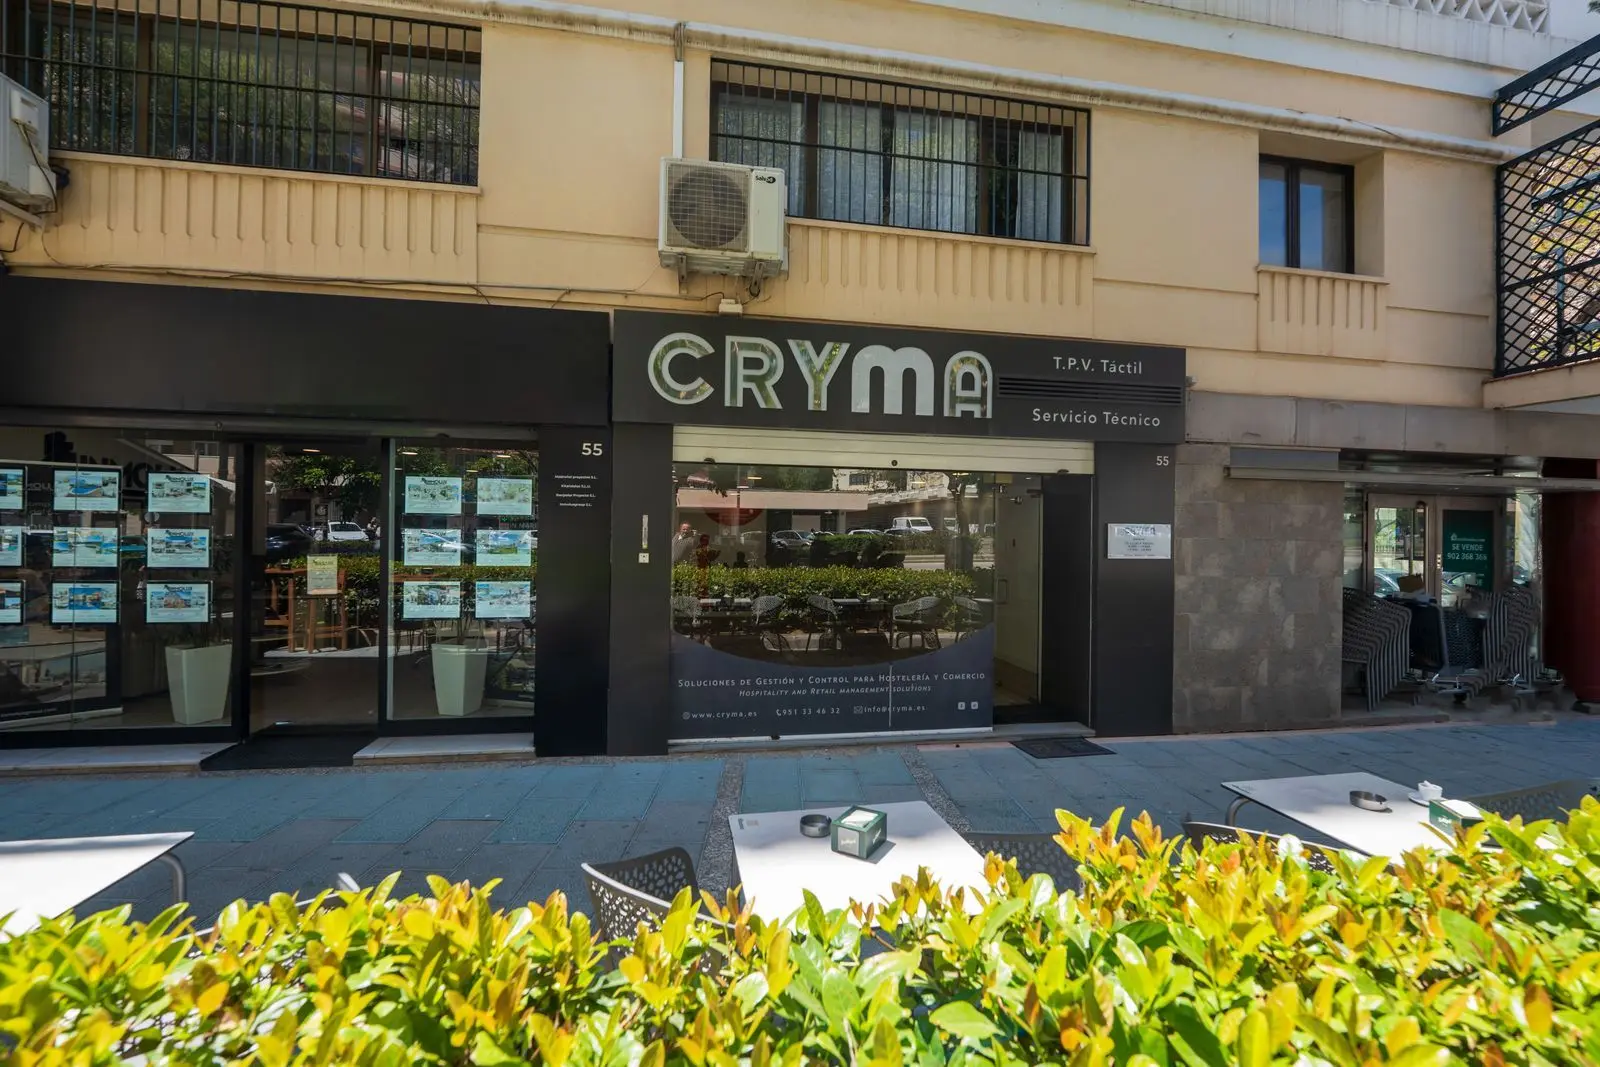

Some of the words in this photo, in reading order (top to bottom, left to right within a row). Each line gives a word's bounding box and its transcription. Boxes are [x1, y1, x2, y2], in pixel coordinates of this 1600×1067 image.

[1052, 356, 1095, 372] T.P.V.
[1100, 359, 1142, 375] Táctil
[647, 331, 993, 419] CRYMA
[1032, 407, 1097, 424] Servicio
[1102, 411, 1161, 427] Técnico
[581, 442, 603, 457] 55
[1155, 455, 1170, 467] 55
[1451, 543, 1461, 551] SE
[1461, 543, 1484, 552] VENDE
[1447, 552, 1460, 560] 902
[691, 711, 758, 720] www.cryma.es
[782, 708, 798, 717] 951
[802, 708, 812, 716] 33
[816, 707, 826, 715] 46
[830, 706, 840, 715] 32
